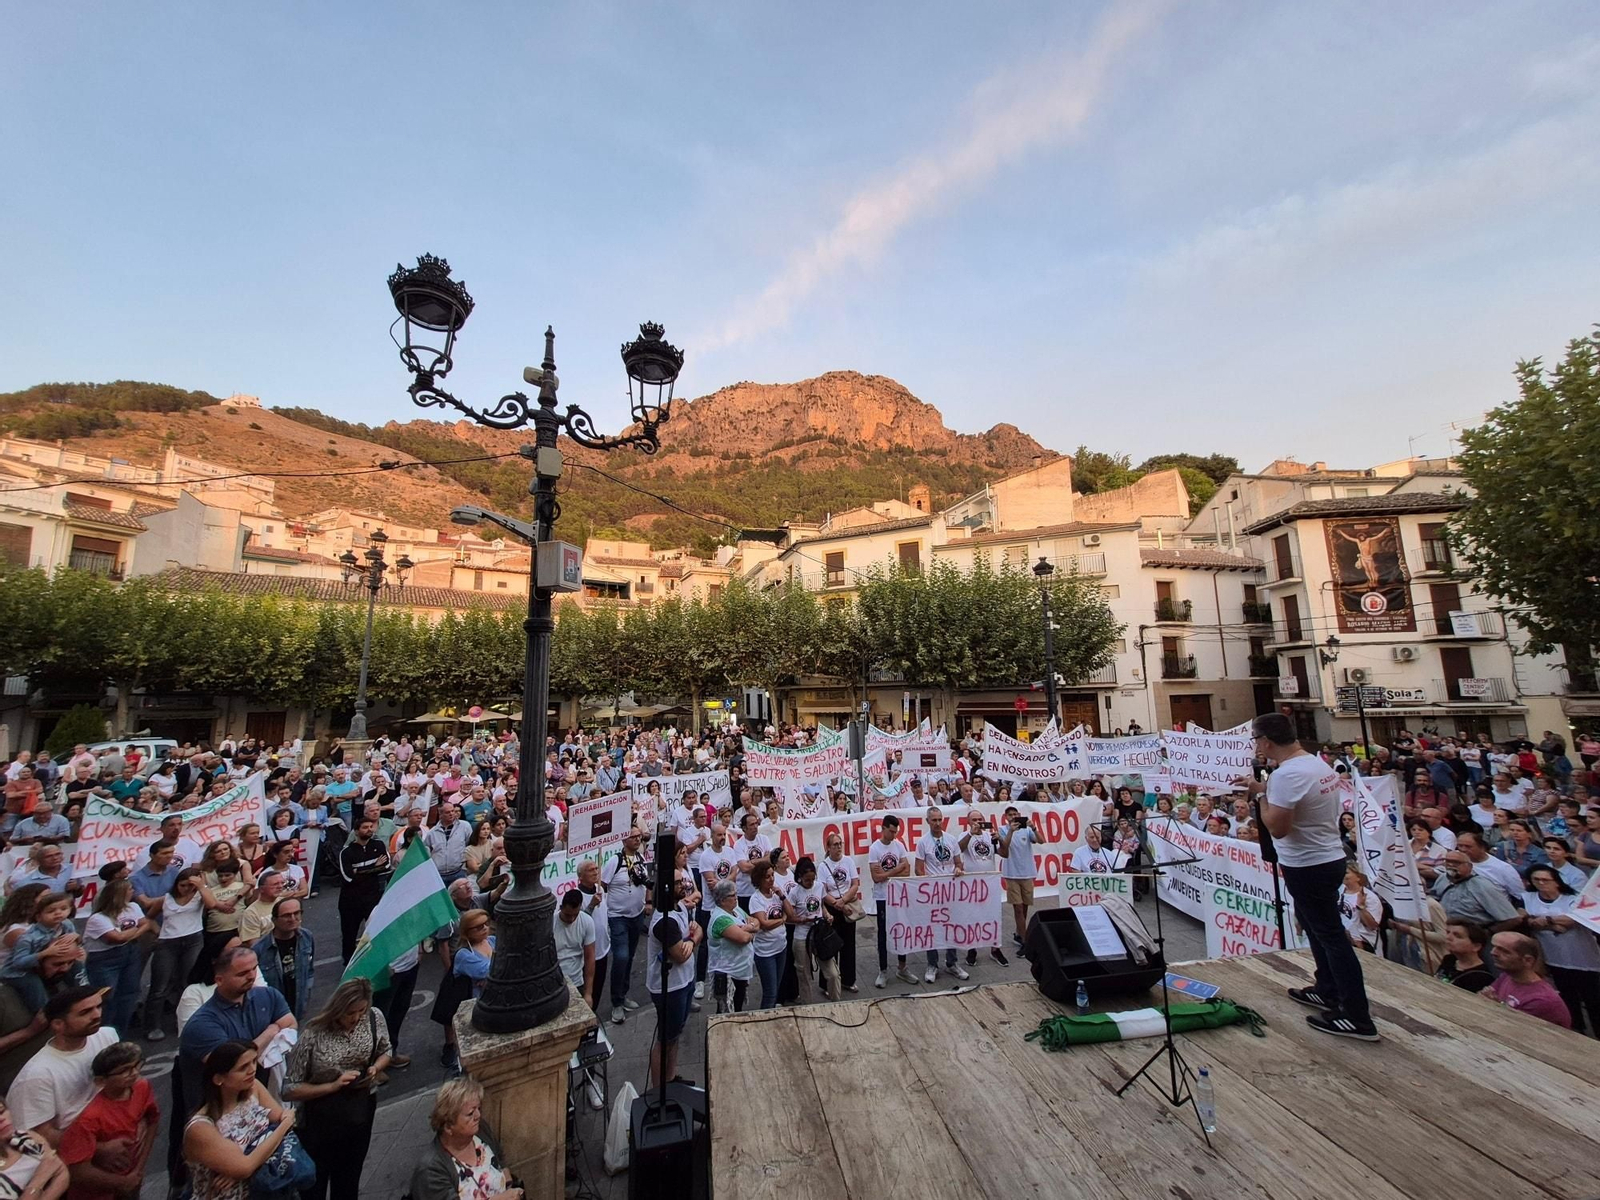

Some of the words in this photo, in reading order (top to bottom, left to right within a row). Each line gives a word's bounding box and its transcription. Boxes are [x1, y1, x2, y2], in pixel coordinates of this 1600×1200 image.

[1386, 690, 1412, 700] Sola
[989, 728, 1037, 751] DELEGADA
[1193, 726, 1247, 736] CARLA
[1163, 734, 1211, 749] CAZORLA
[1215, 740, 1254, 751] UNIDA
[988, 744, 1002, 756] HA
[1003, 749, 1046, 762] PENSADO
[1088, 755, 1120, 765] UEREMOS
[1169, 750, 1188, 762] POR
[1195, 753, 1210, 765] SU
[1215, 756, 1253, 768] SALUD
[987, 761, 999, 772] EN
[1001, 763, 1064, 779] NOSOTROS?
[1177, 767, 1189, 778] AL
[674, 779, 706, 795] NUESTRA
[568, 840, 597, 854] CENTRO
[597, 835, 619, 846] SALUD
[620, 831, 630, 840] YA!
[779, 827, 815, 866] AL
[1199, 841, 1210, 854] NO
[1065, 876, 1127, 893] GERENTE
[930, 908, 950, 923] ES
[890, 922, 935, 950] PARA
[943, 920, 998, 946] TODOS!
